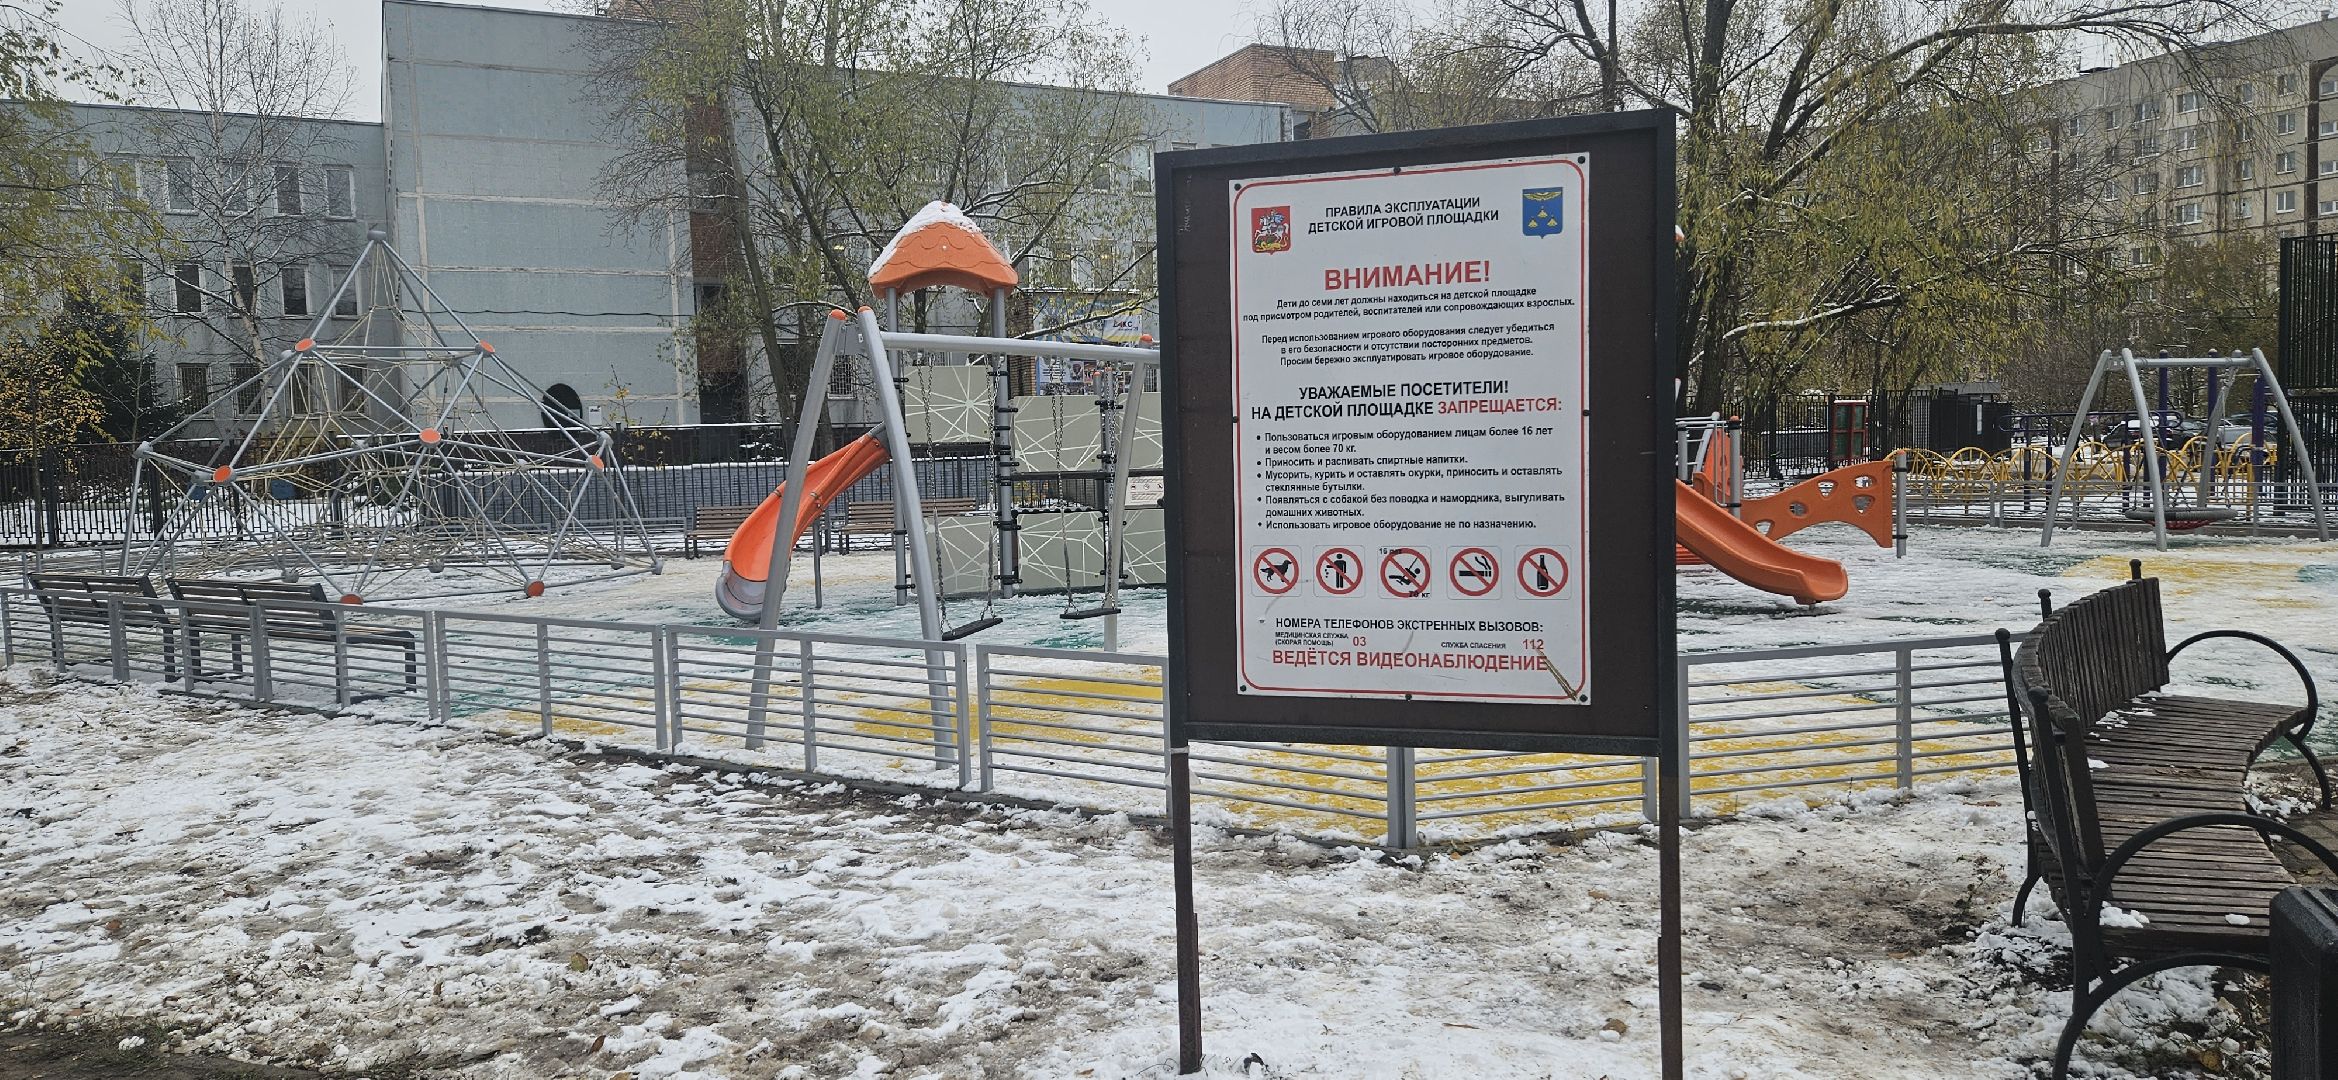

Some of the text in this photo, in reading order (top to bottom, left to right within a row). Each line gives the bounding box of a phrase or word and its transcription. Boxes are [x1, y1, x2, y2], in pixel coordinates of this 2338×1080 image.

[1325, 197, 1481, 219] ПРАВИЛА ЭКСПЛУАТАЦИИ
[1308, 209, 1499, 235] ДЕТСКОЙ ИГРОВОЙ ПЛОЩАДКИ
[1324, 260, 1490, 291] ВНИМАНИЕ!
[1277, 287, 1537, 310] Дети до семи лет должны находиться на детской площадке
[1243, 298, 1575, 324] под присмотром родителей, воспитателей или сопровождающих взрослых.
[1262, 323, 1555, 346] Перед использованием игрового оборудования следует убедиться
[1289, 346, 1302, 354] его
[1303, 343, 1361, 353] безопасности
[1371, 341, 1420, 352] отсутствии
[1422, 339, 1479, 349] посторонних
[1481, 337, 1533, 347] предметов.
[1280, 348, 1533, 367] Просим бережно эксплуатировать игровое оборудование.
[1299, 380, 1509, 400] УВАЖАЕМЫЕ ПОСЕТИТЕЛИ!
[1251, 398, 1562, 421] НА ДЕТСКОЙ ПЛОЩАДКЕ ЗАПРЕЩАЕТСЯ:
[1265, 426, 1553, 442] Пользоваться игровым оборудованием лицам более 16 лет
[1303, 444, 1330, 453] более
[1333, 444, 1344, 453] 70
[1346, 445, 1357, 453] кг.
[1265, 457, 1315, 468] Приносить
[1325, 457, 1374, 468] распивать
[1377, 457, 1424, 467] спиртные
[1426, 455, 1468, 464] напитки.
[1265, 470, 1312, 481] Мусорить,
[1314, 470, 1346, 480] курить
[1357, 469, 1406, 478] оставлять
[1408, 469, 1444, 479] окурки,
[1446, 468, 1499, 479] приносить
[1502, 468, 1508, 476] и
[1511, 467, 1563, 476] оставлять
[1265, 481, 1365, 493] стеклянные бутылки.
[1266, 495, 1320, 505] Появляться
[1330, 494, 1368, 504] собакой
[1370, 493, 1387, 503] без
[1389, 495, 1429, 505] поводка
[1440, 494, 1502, 505] намордника,
[1505, 493, 1565, 504] выгуливать
[1266, 508, 1365, 518] домашних животных.
[1266, 520, 1536, 531] Использовать игровое оборудование не по назначению.
[1276, 618, 1544, 633] НОМЕРА ТЕЛЕФОНОВ ЭКСТРЕННЫХ ВЫЗОВОВ:
[1352, 636, 1367, 647] 03
[1441, 641, 1469, 649] СЛУЖБА
[1522, 638, 1544, 650] 112
[1272, 647, 1548, 673] ВЕДЁТСЯ ВИДЕОНАБЛЮДЕНИЕ
